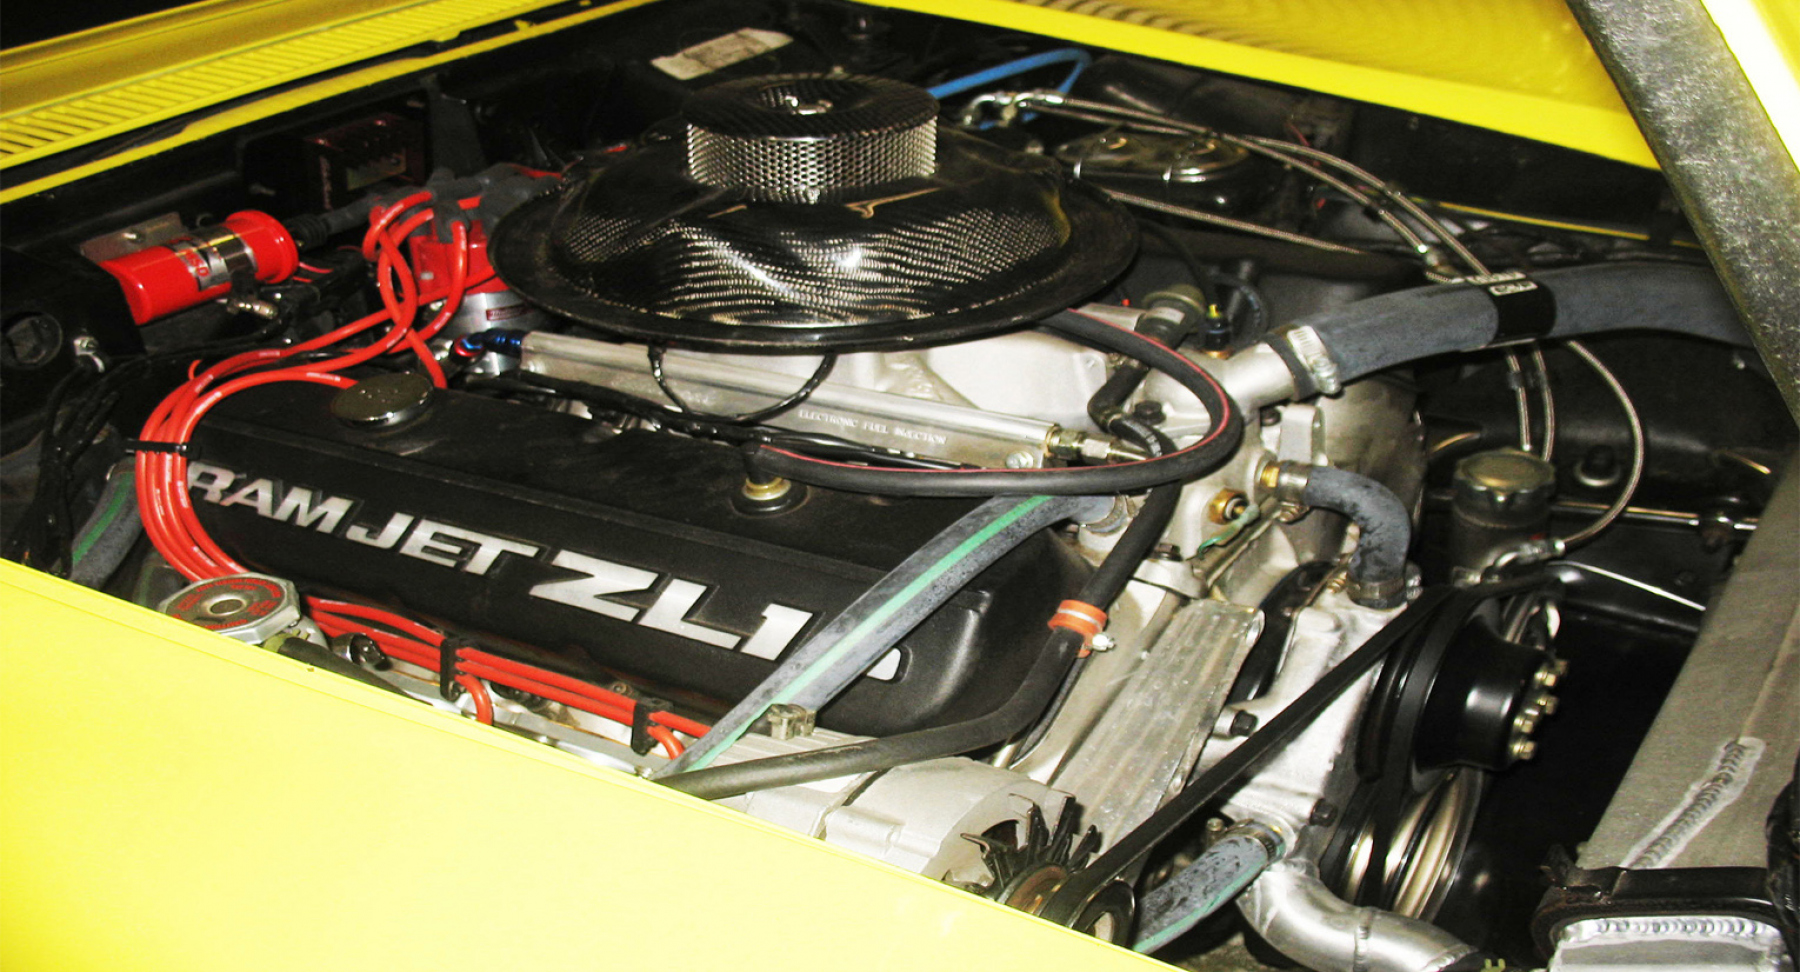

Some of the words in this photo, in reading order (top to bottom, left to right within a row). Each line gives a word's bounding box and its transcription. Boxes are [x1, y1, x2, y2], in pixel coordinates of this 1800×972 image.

[799, 409, 858, 428] ELECTRONIC
[862, 422, 889, 435] FUEL
[894, 427, 947, 445] INJECTION
[187, 461, 352, 534] RAM
[346, 512, 540, 576] JET
[529, 549, 814, 661] ZL1
